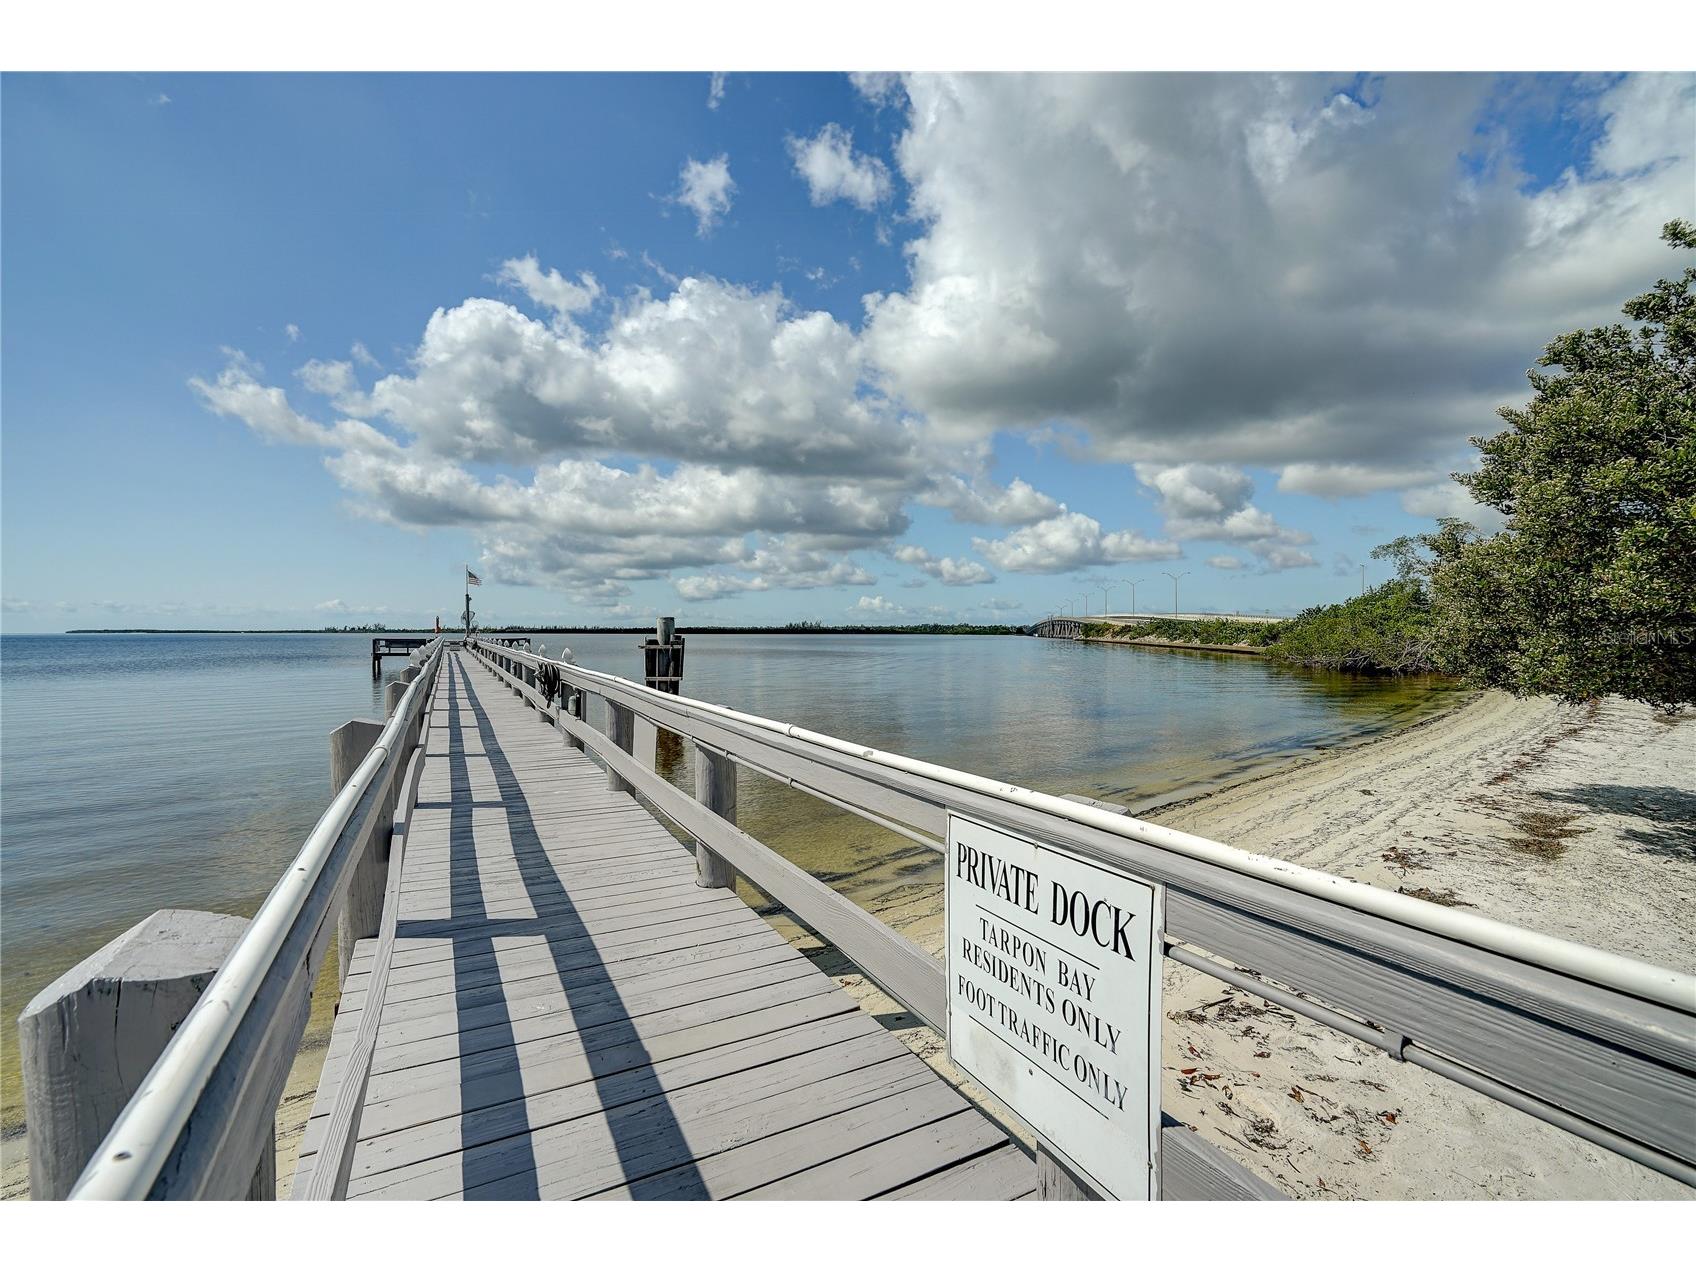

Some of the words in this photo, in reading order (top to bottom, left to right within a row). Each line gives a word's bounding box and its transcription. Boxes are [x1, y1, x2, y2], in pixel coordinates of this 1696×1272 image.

[956, 841, 1039, 915] PRIVATE
[1050, 880, 1136, 962] DOCK
[979, 917, 1047, 976] TARPON
[1057, 960, 1096, 1002] BAY
[958, 974, 996, 1018] FOOT
[998, 1001, 1070, 1071] TRAFFIC
[1074, 1055, 1128, 1112] ONLY
[962, 937, 1055, 1014] RESIDENTS
[1062, 999, 1121, 1055] ONLY
